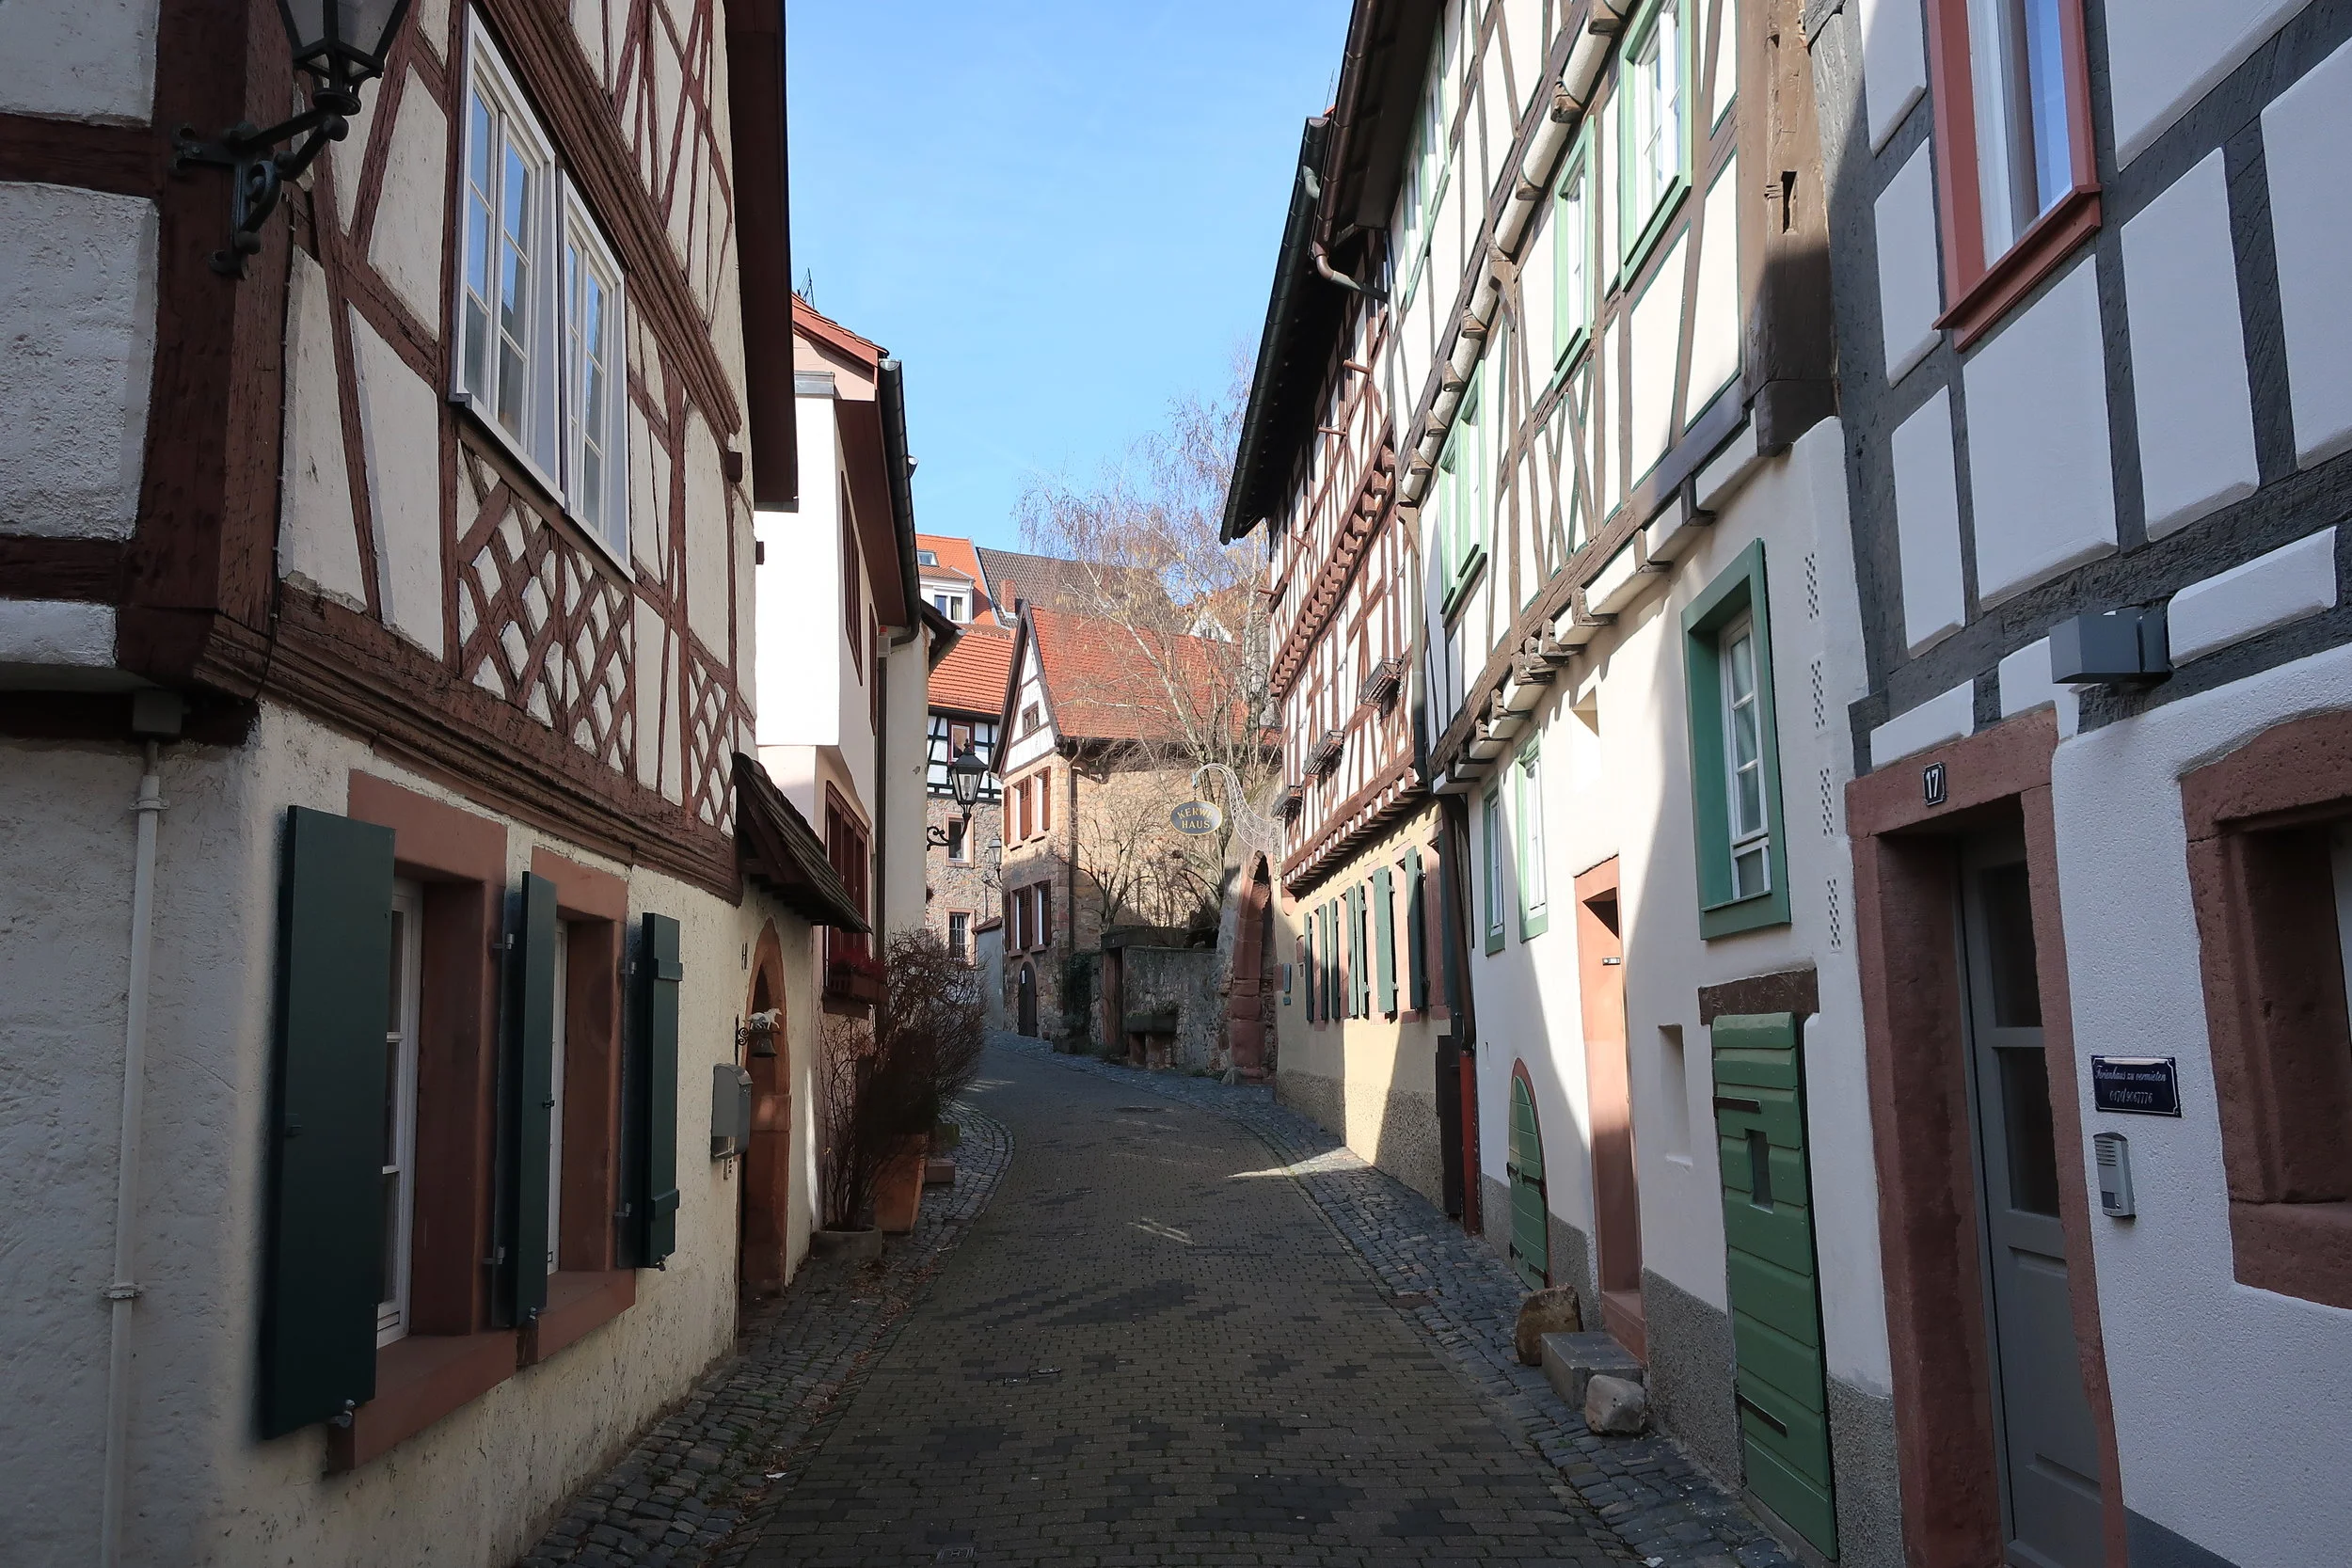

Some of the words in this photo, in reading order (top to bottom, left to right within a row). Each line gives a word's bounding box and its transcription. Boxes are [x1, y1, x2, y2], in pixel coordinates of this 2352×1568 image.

[1926, 768, 1939, 799] 17
[1177, 807, 1214, 820] KERWE
[1182, 820, 1211, 829] HAUS
[2126, 1072, 2135, 1081] zu
[2136, 1070, 2167, 1082] vermieten
